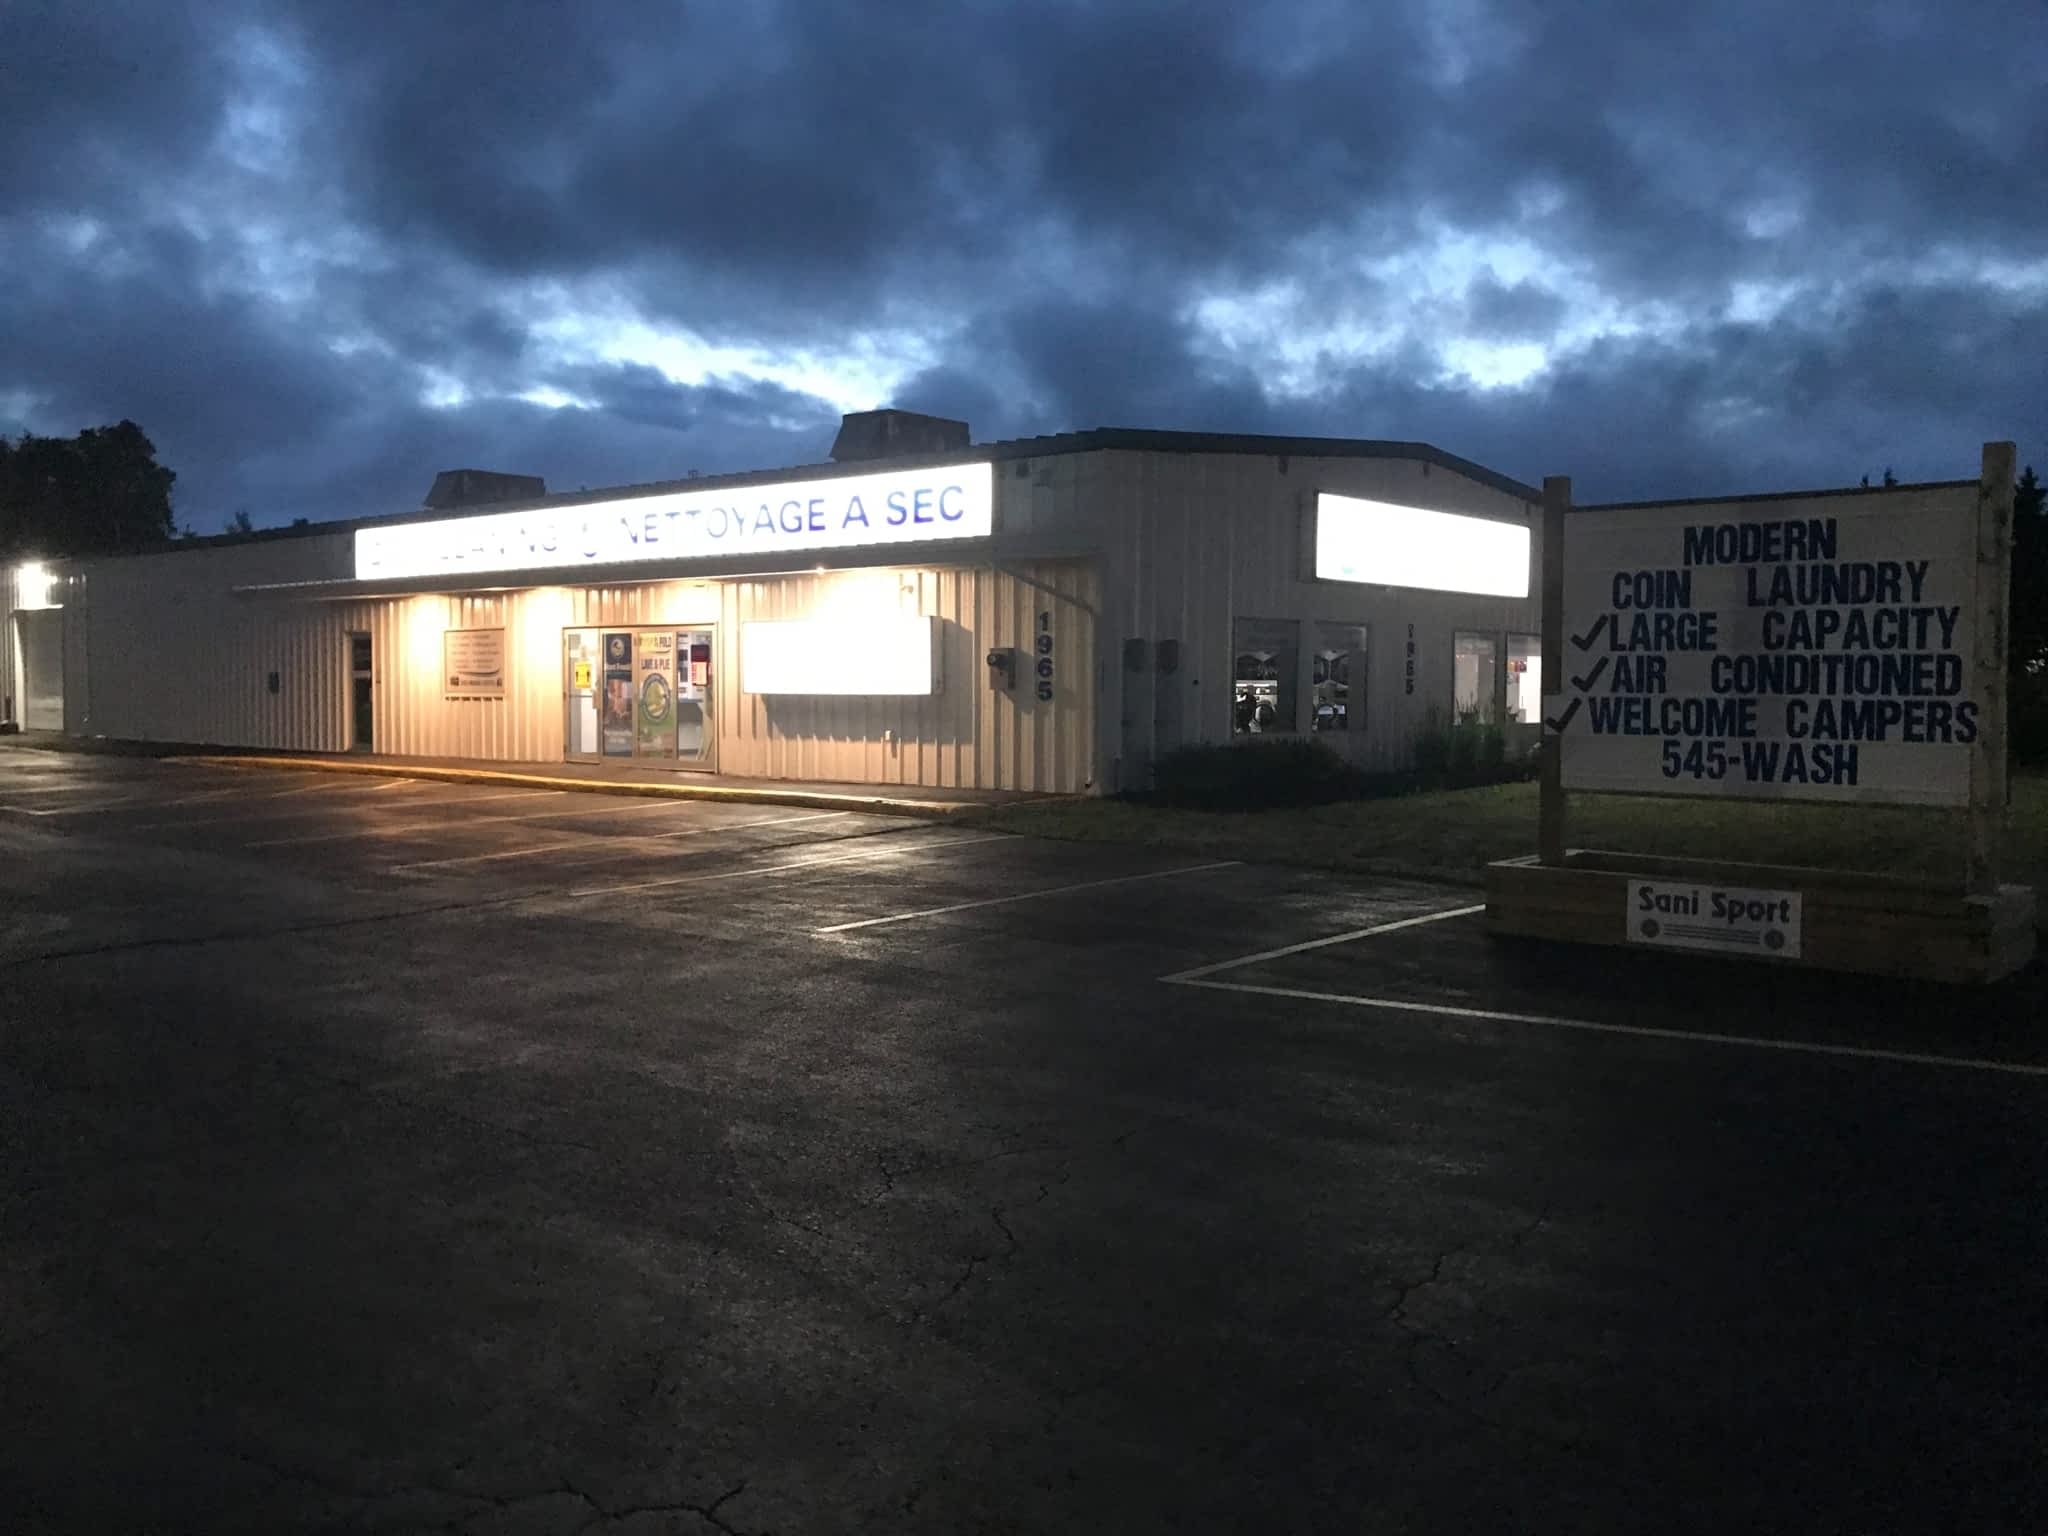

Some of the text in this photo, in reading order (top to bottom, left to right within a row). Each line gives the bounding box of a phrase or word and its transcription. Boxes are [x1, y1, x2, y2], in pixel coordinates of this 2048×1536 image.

[842, 496, 870, 529] A
[886, 485, 965, 527] SEC
[1684, 518, 1837, 565] MODERN
[1612, 560, 1929, 609] COIN LAUNDRY
[1609, 606, 1960, 652] LARGE CAPACITY
[1038, 611, 1053, 701] 1965
[1610, 654, 1962, 697] AIR CONDITIONED
[1590, 697, 1978, 743] WELCOME CAMPERS
[1662, 740, 1858, 785] 545-WASH
[1638, 886, 1791, 924] Sani Sport
